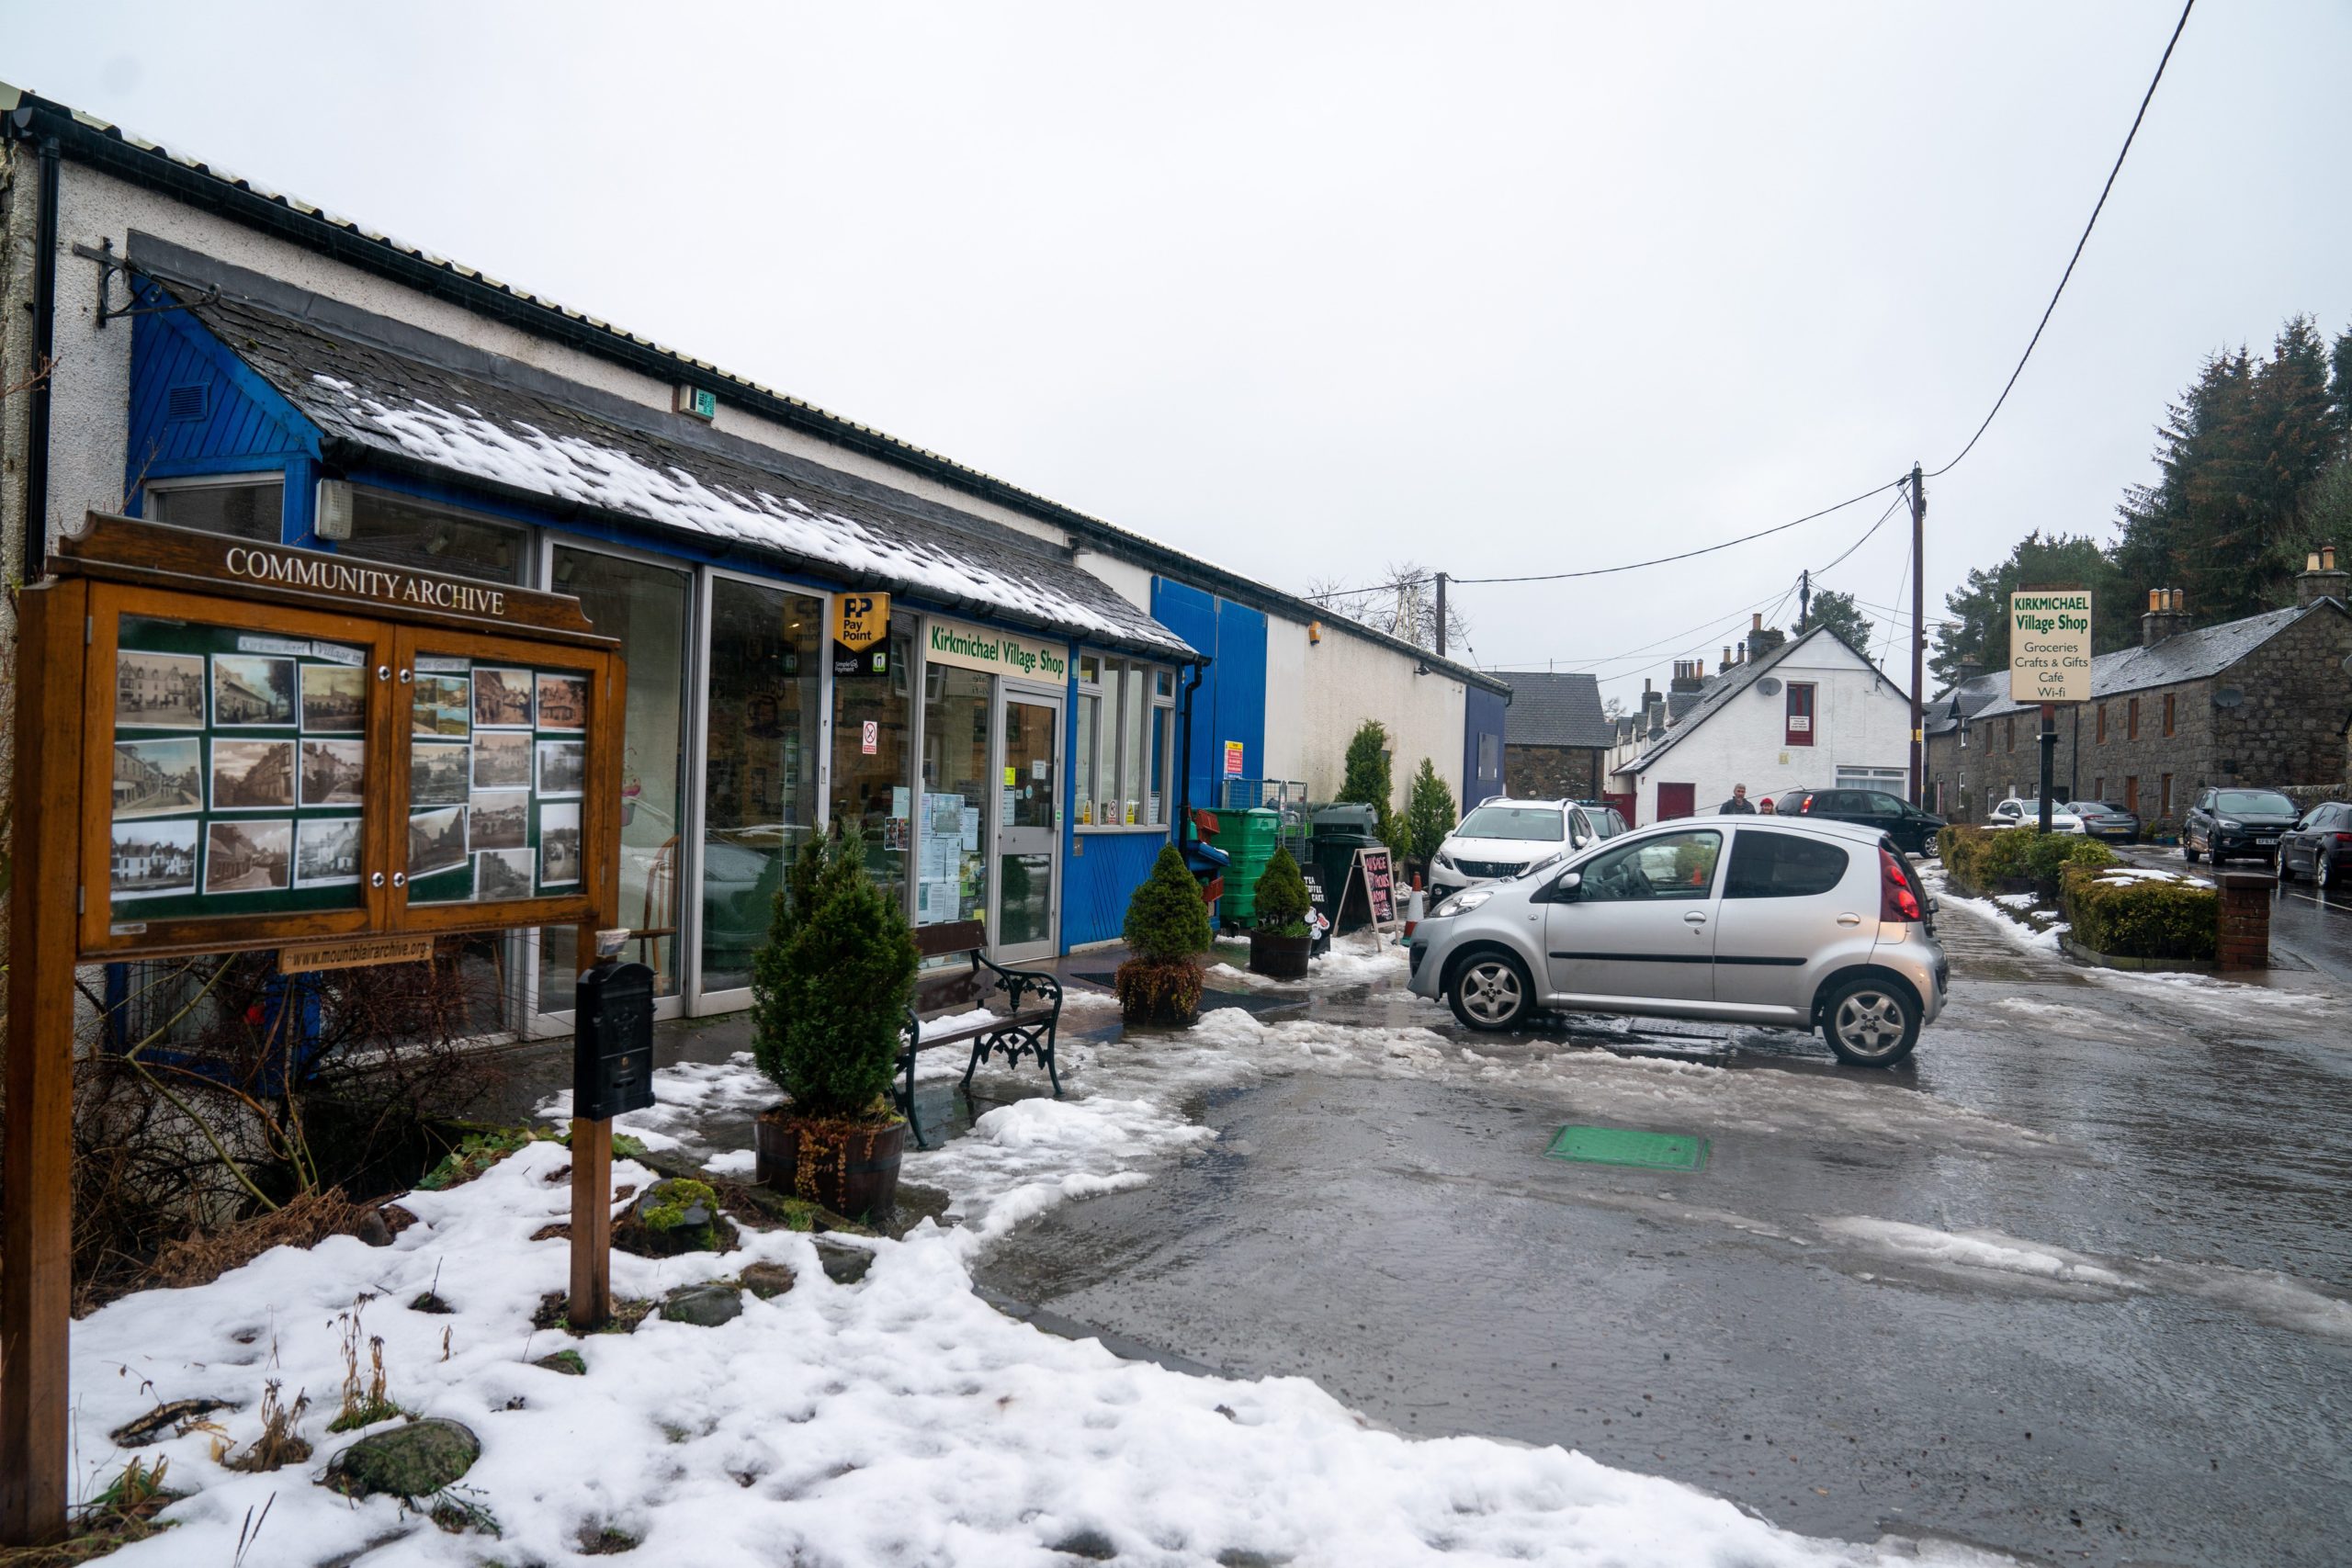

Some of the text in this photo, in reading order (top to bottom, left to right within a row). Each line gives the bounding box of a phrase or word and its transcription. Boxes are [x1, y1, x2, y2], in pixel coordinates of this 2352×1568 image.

[226, 547, 504, 615] COMMUNITY ARCHIVE
[2014, 597, 2089, 611] KIRKMICHAEL
[843, 619, 863, 632] Pay
[2016, 614, 2088, 635] Village Shop
[842, 630, 872, 641] Point
[314, 642, 350, 663] Village
[932, 625, 1064, 680] Kirkmichael Village Shop
[2024, 641, 2078, 653] Groceries
[2015, 657, 2088, 668] Crafts & Gifts
[2039, 671, 2064, 682] Café
[2037, 686, 2065, 697] Wi-fi
[1304, 876, 1316, 885] TEA
[292, 941, 427, 966] www.mountblairarchive.org
